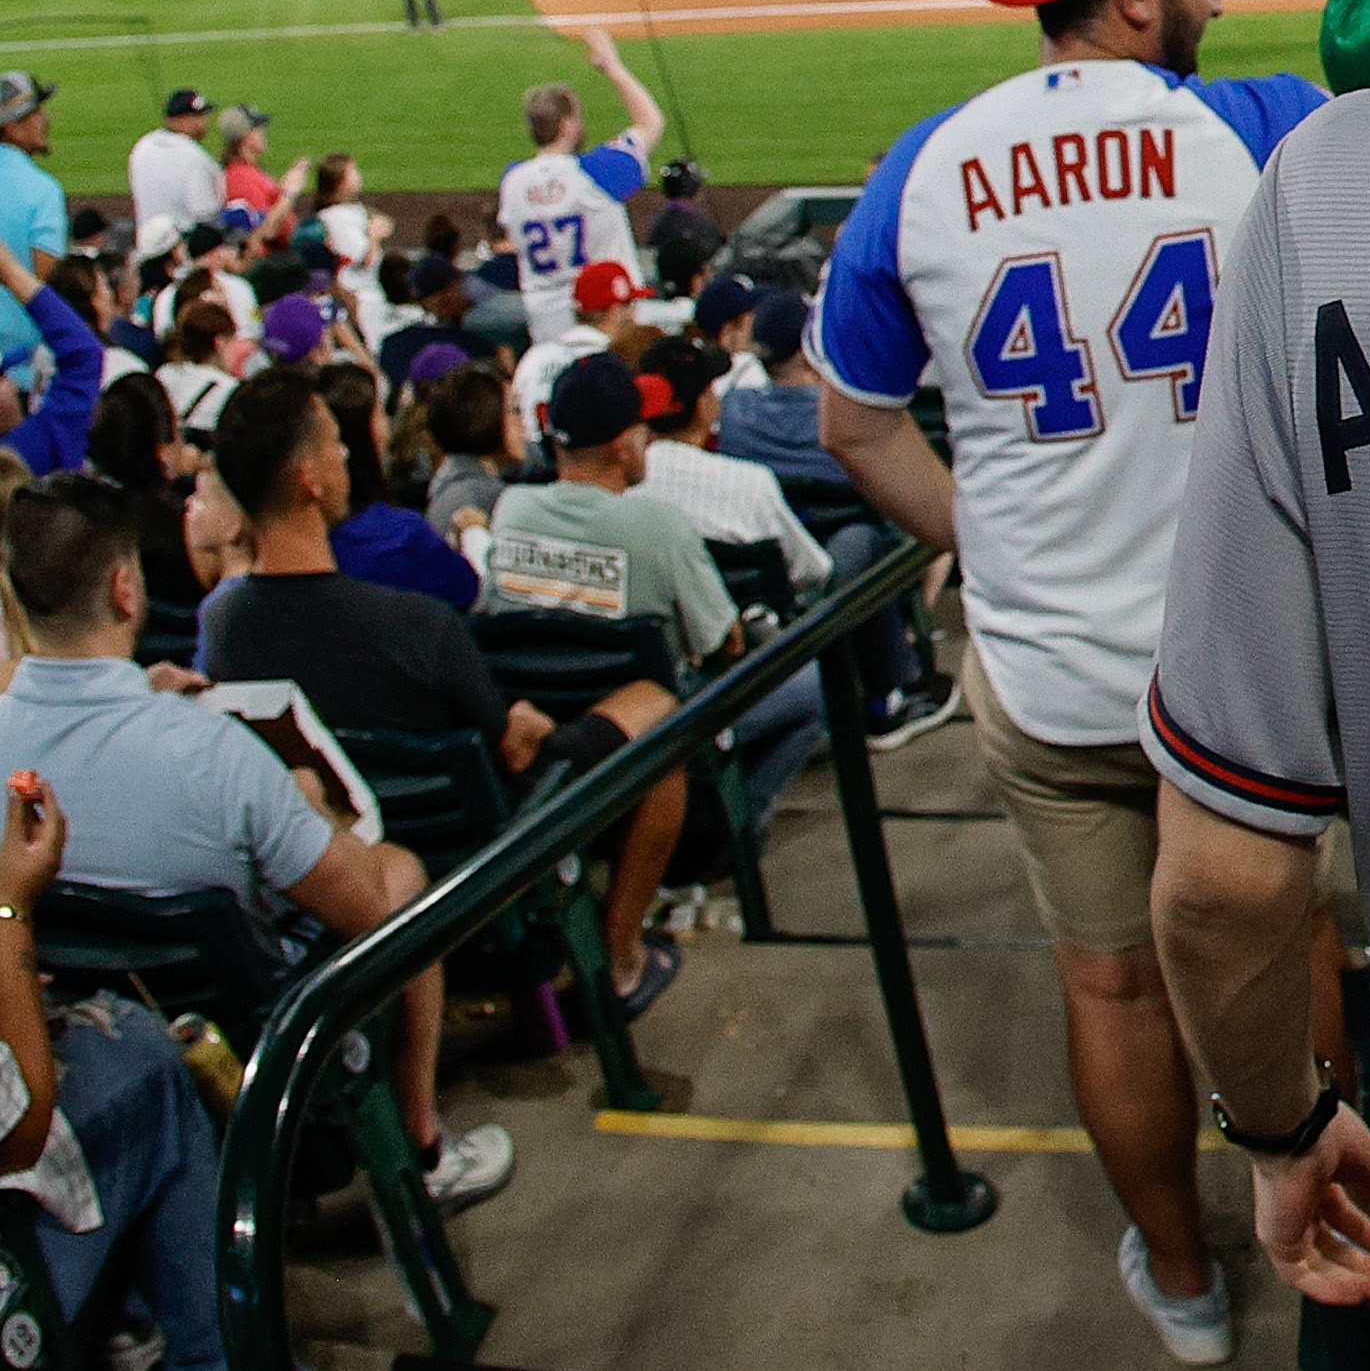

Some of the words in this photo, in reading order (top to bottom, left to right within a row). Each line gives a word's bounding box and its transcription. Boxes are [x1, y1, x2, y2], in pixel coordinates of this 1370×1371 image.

[961, 128, 1177, 232] AARON
[522, 213, 587, 273] 27
[964, 227, 1220, 443] 44
